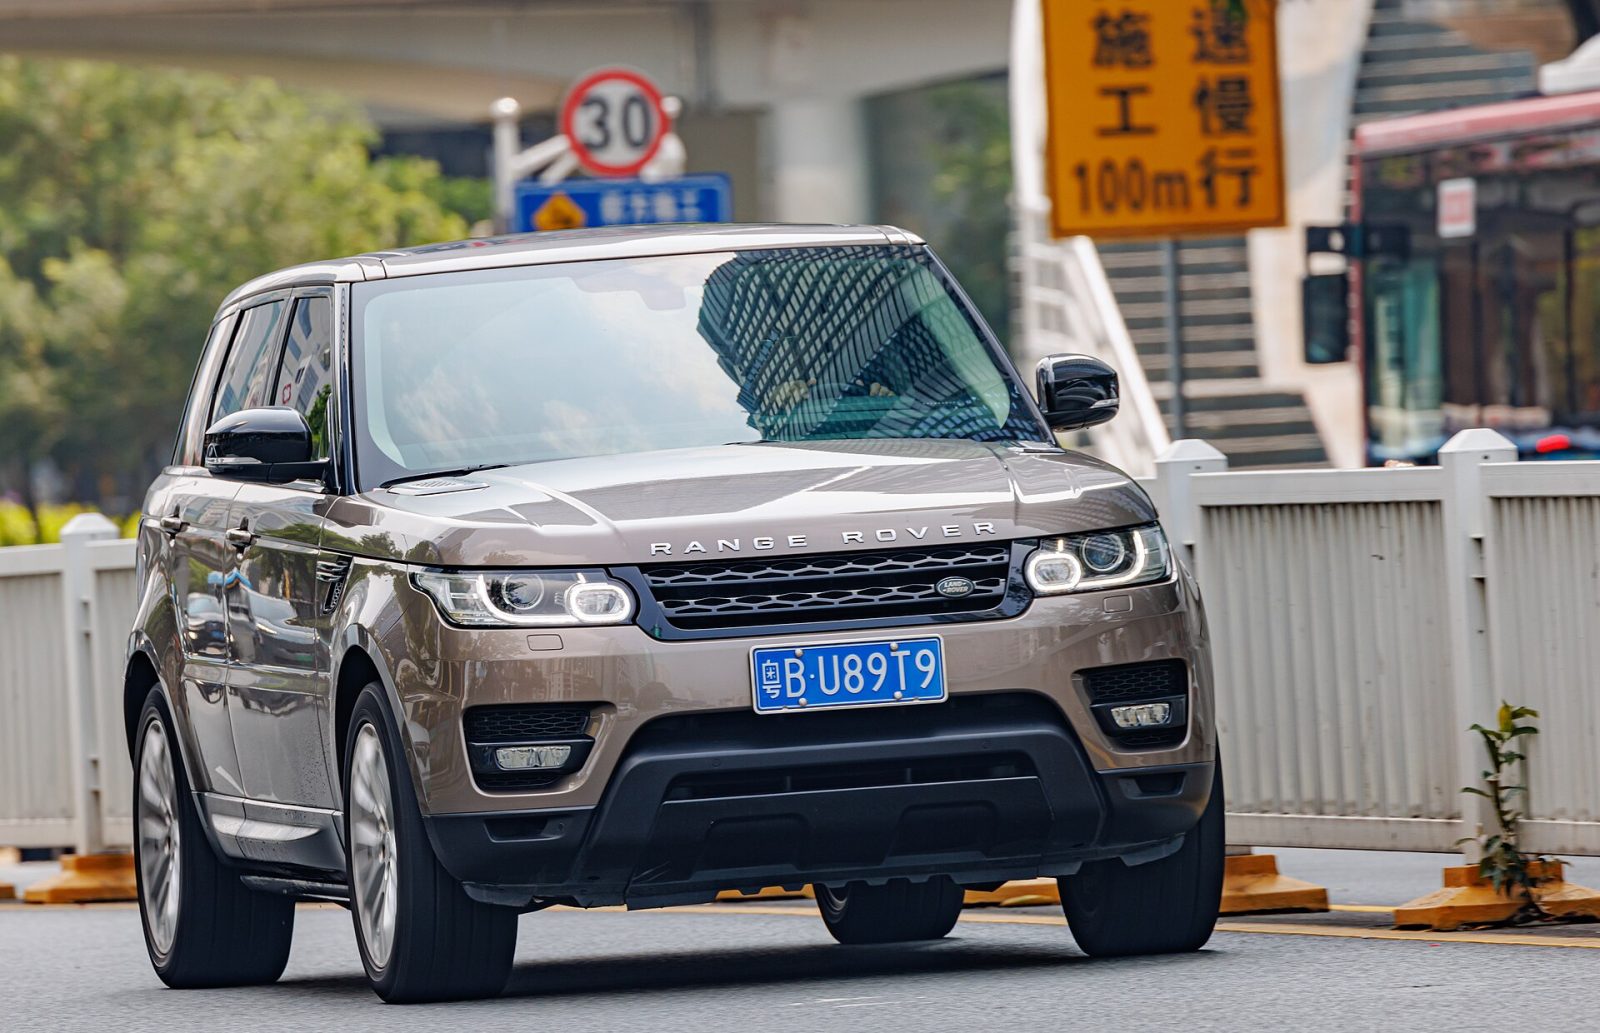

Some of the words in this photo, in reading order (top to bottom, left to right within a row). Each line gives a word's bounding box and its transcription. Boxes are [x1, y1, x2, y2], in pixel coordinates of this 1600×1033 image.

[1093, 9, 1155, 137] 施工
[582, 94, 652, 150] 30
[1074, 158, 1191, 214] 100m
[650, 534, 807, 556] RANGE
[842, 521, 997, 545] ROVER
